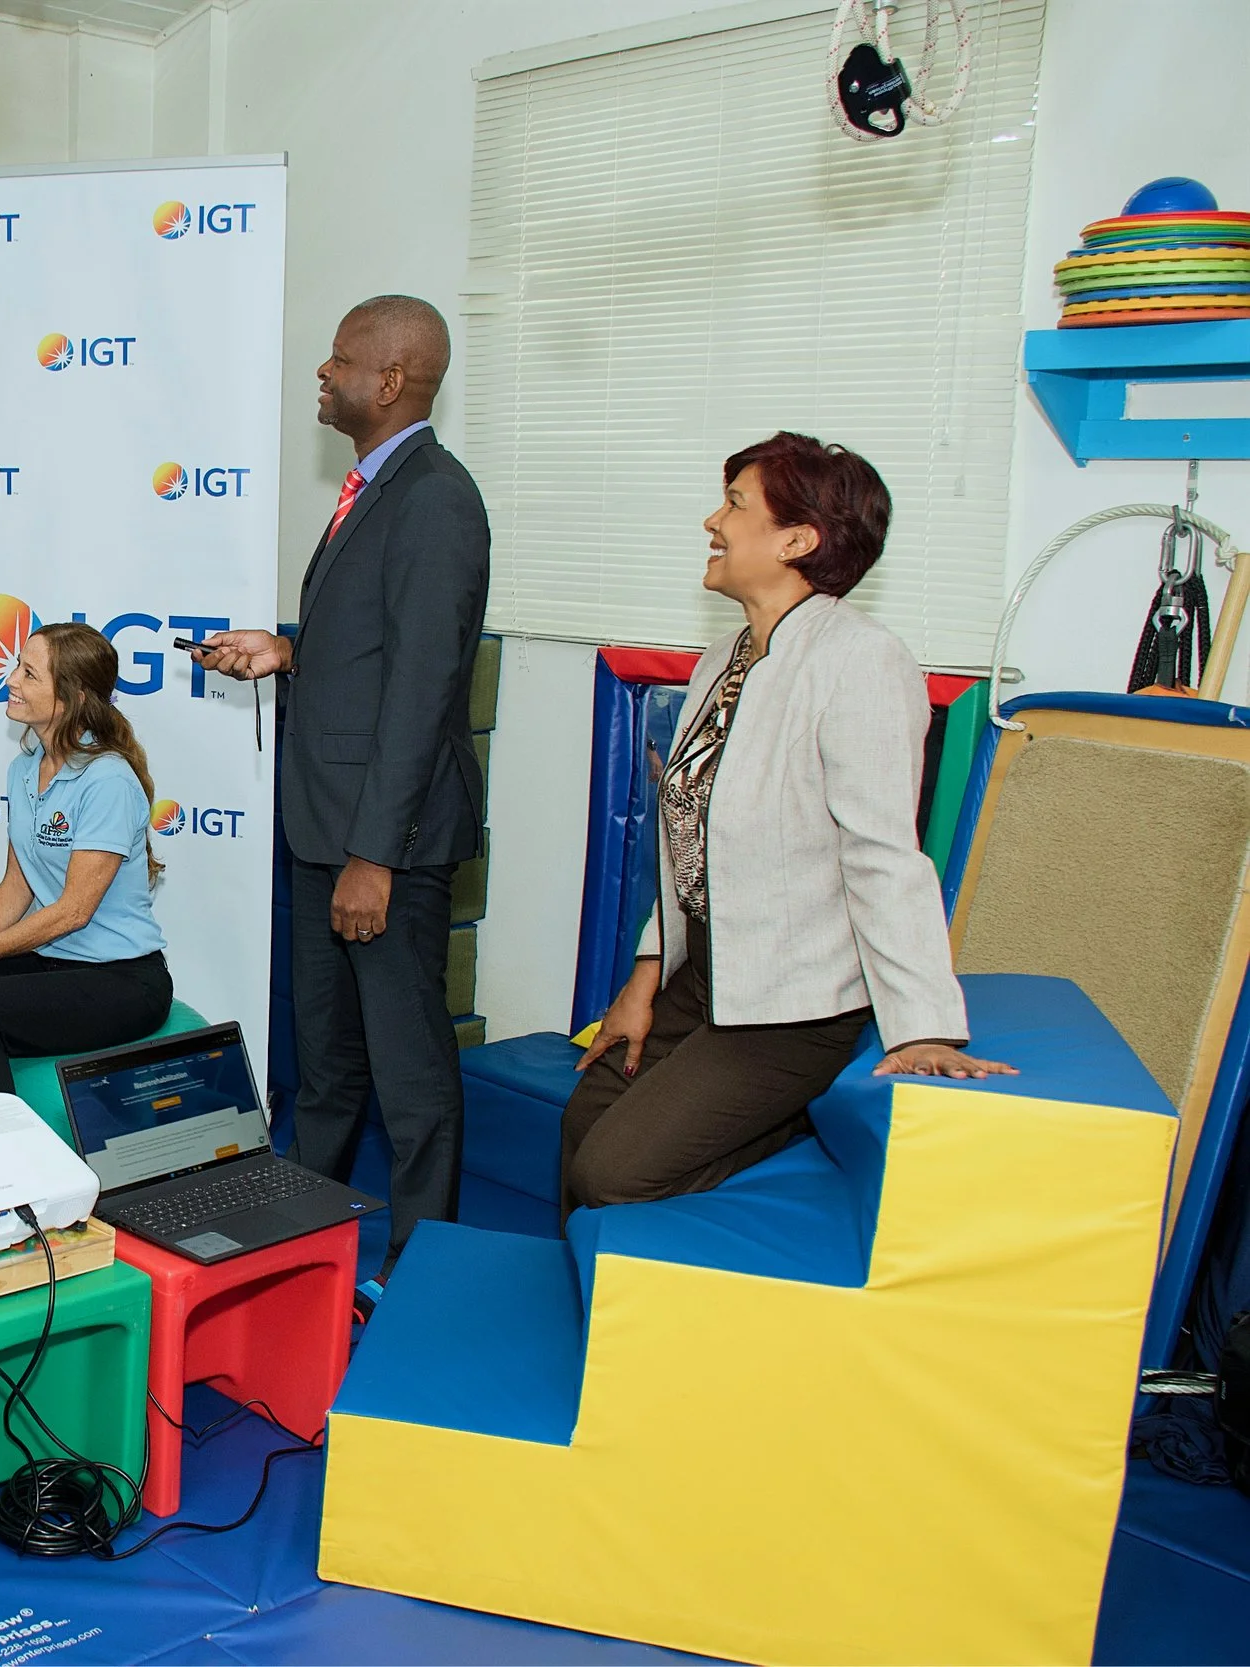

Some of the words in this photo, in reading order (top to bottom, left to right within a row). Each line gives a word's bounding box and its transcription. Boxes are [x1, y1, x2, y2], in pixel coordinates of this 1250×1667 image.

[198, 203, 256, 234] IGT
[81, 337, 136, 366] IGT
[195, 467, 250, 496] IGT
[72, 612, 230, 698] GT
[193, 807, 246, 836] IGT
